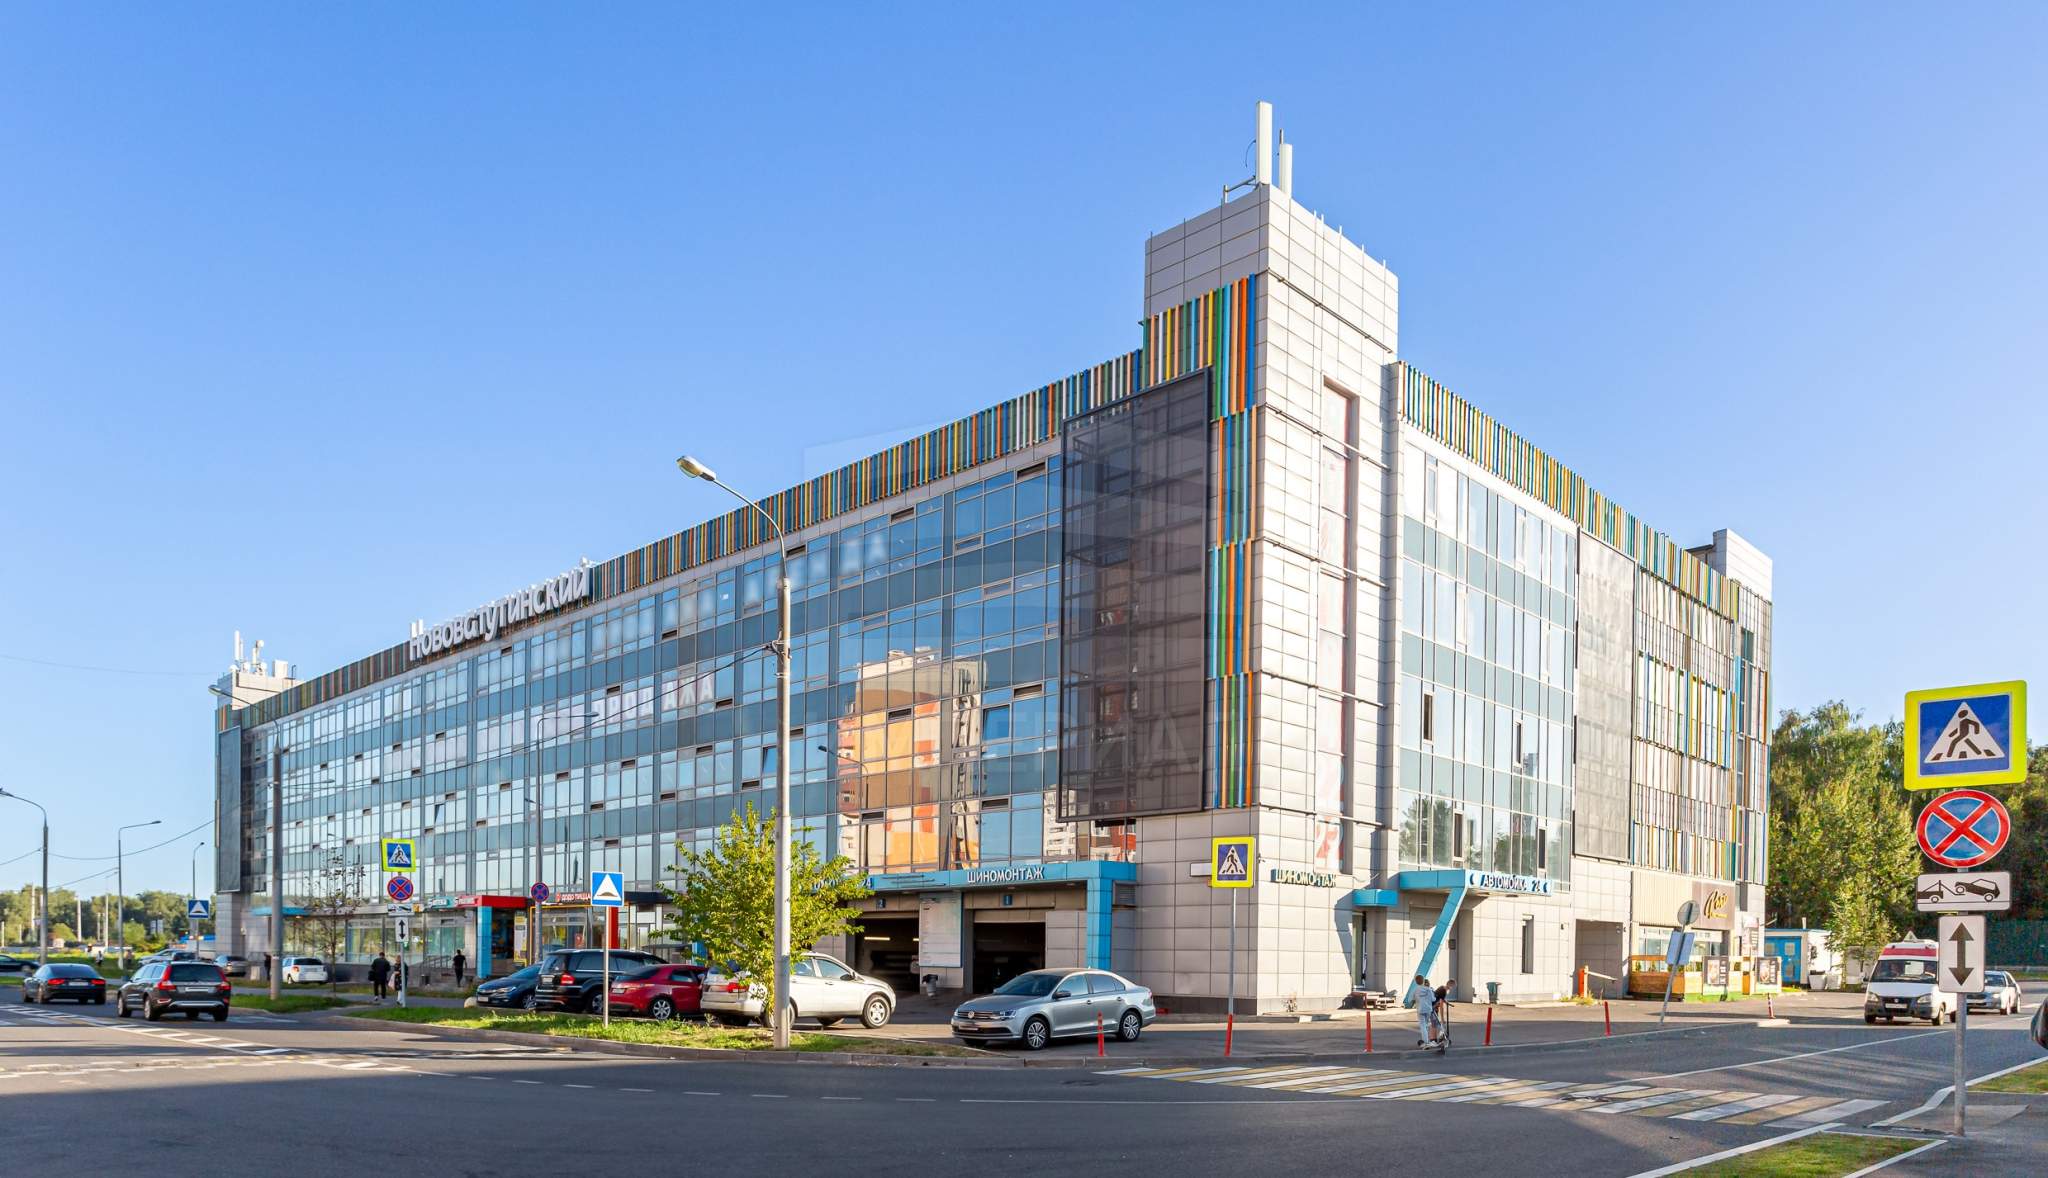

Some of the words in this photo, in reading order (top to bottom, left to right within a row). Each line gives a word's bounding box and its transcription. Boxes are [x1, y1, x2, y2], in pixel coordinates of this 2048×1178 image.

[967, 866, 1045, 883] ШИНОМОНТАЖ
[1275, 869, 1337, 887] ШИНОМОНТАЖ
[1482, 874, 1529, 891] АВТОМОЙКА
